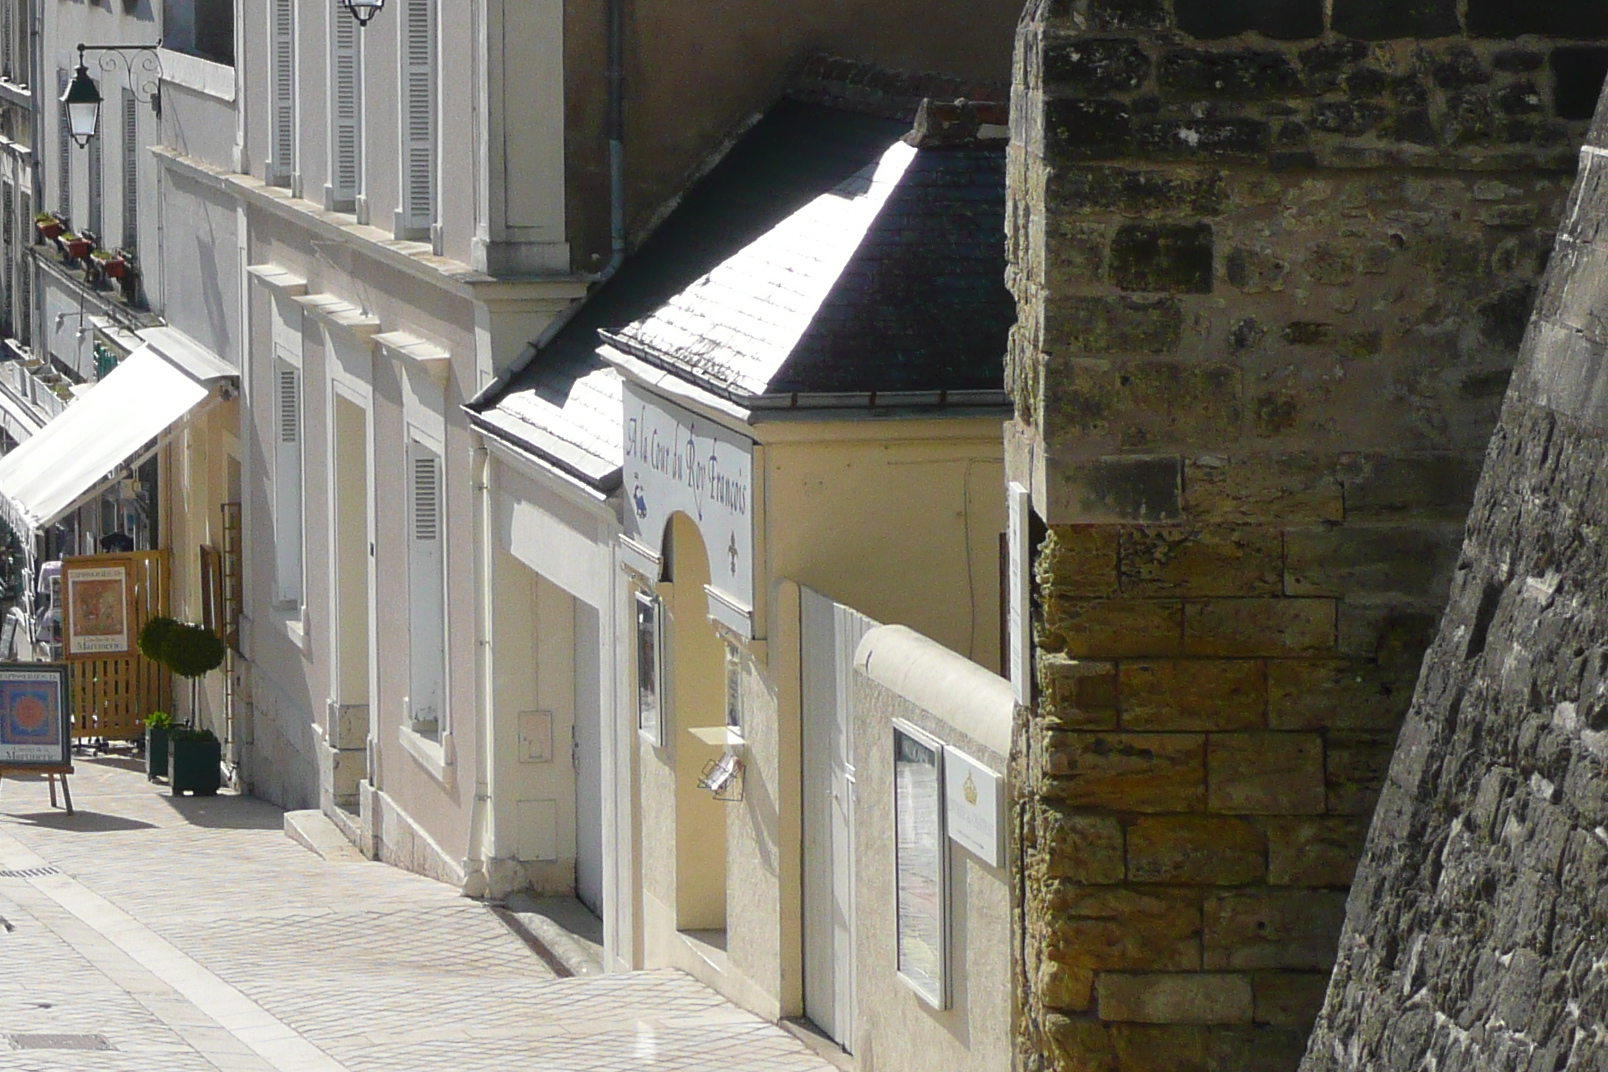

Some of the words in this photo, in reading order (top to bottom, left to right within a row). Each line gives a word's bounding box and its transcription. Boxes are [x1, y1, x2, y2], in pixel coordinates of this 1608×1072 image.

[640, 404, 648, 463] la
[651, 428, 670, 476] Cour
[672, 421, 683, 483] du
[686, 422, 706, 522] Roy
[708, 437, 747, 516] François
